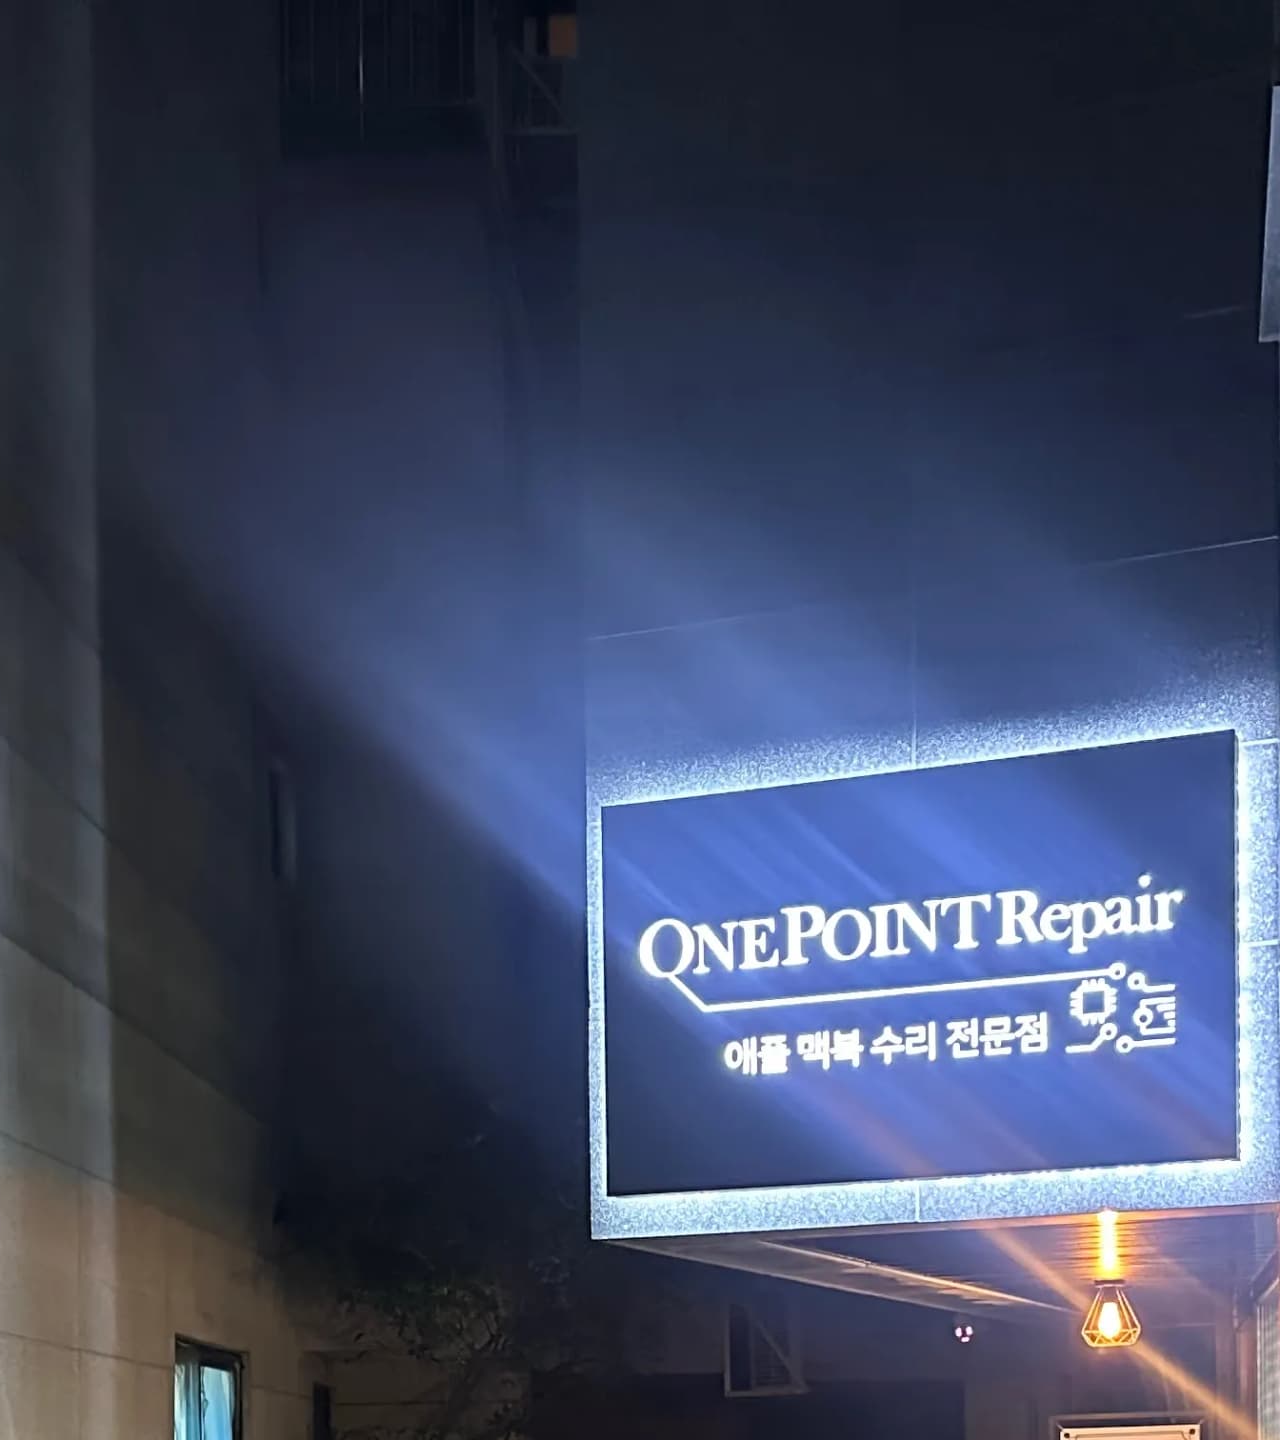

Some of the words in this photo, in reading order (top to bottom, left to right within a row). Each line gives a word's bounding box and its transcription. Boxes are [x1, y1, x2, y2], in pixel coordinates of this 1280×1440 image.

[996, 874, 1184, 954] Repair
[724, 1034, 791, 1075] 애플
[796, 1028, 864, 1070] 맥북
[870, 1020, 937, 1064] 수리
[945, 1011, 1049, 1058] 전문점
